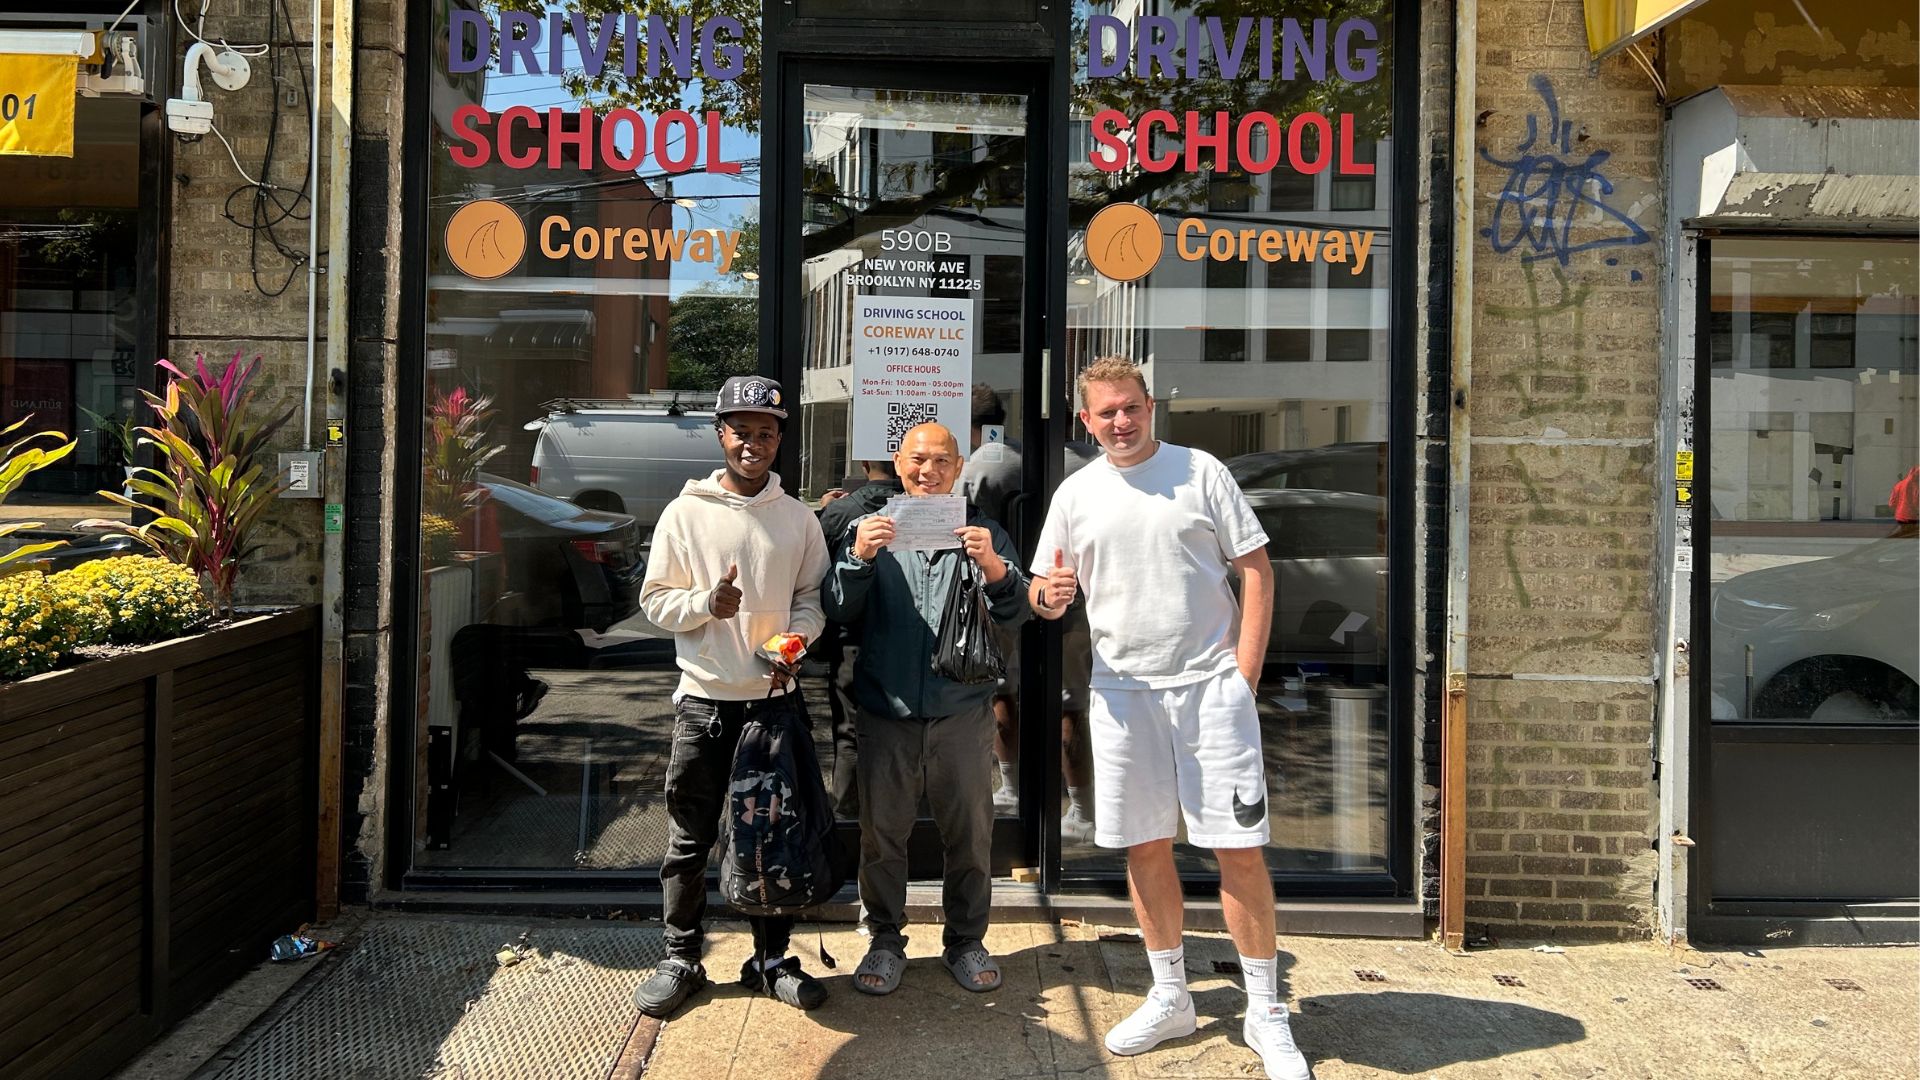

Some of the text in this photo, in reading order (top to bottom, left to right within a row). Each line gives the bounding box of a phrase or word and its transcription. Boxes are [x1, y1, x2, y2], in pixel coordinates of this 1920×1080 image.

[449, 9, 744, 80] DRIVING
[1088, 15, 1378, 83] DRIVING
[1, 93, 37, 121] 01
[449, 104, 742, 173] SCHOOL
[1088, 109, 1375, 175] SCHOOL
[539, 215, 741, 275] Coreway
[881, 229, 951, 252] 590B
[1176, 217, 1375, 276] Coreway
[864, 259, 965, 274] NEW YORK AVE
[846, 274, 981, 290] BROOKLYN NY 11225
[863, 307, 965, 321] DRIVING SCHOOL
[863, 325, 964, 341] COREWAY LLC
[868, 346, 960, 357] +1 (917) 648-0740
[886, 364, 941, 374] OFFICE HOURS
[862, 378, 893, 386] Mon-Fri:
[896, 379, 927, 387] 10:00am
[932, 380, 964, 388] 05:00pm
[862, 388, 893, 396] Sat-Sun:
[896, 389, 927, 397] 11:00am
[932, 390, 964, 398] 05:00pm
